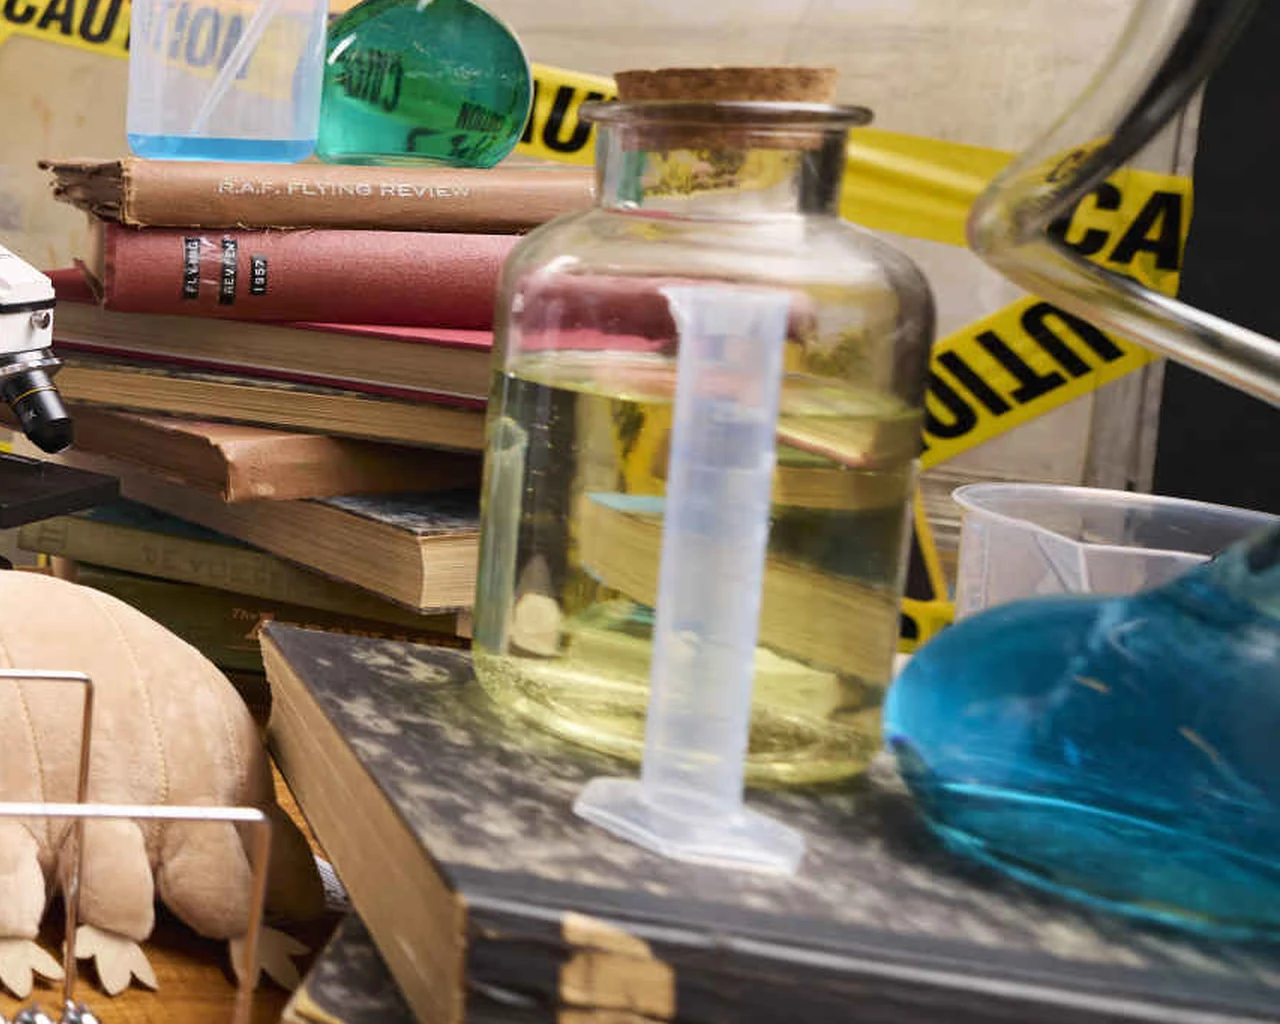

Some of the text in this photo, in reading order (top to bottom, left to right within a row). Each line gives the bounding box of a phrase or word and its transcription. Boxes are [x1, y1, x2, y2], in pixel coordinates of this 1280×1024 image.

[217, 180, 471, 198] R.A.F. FLYING REVIEW
[253, 259, 268, 294] 1957
